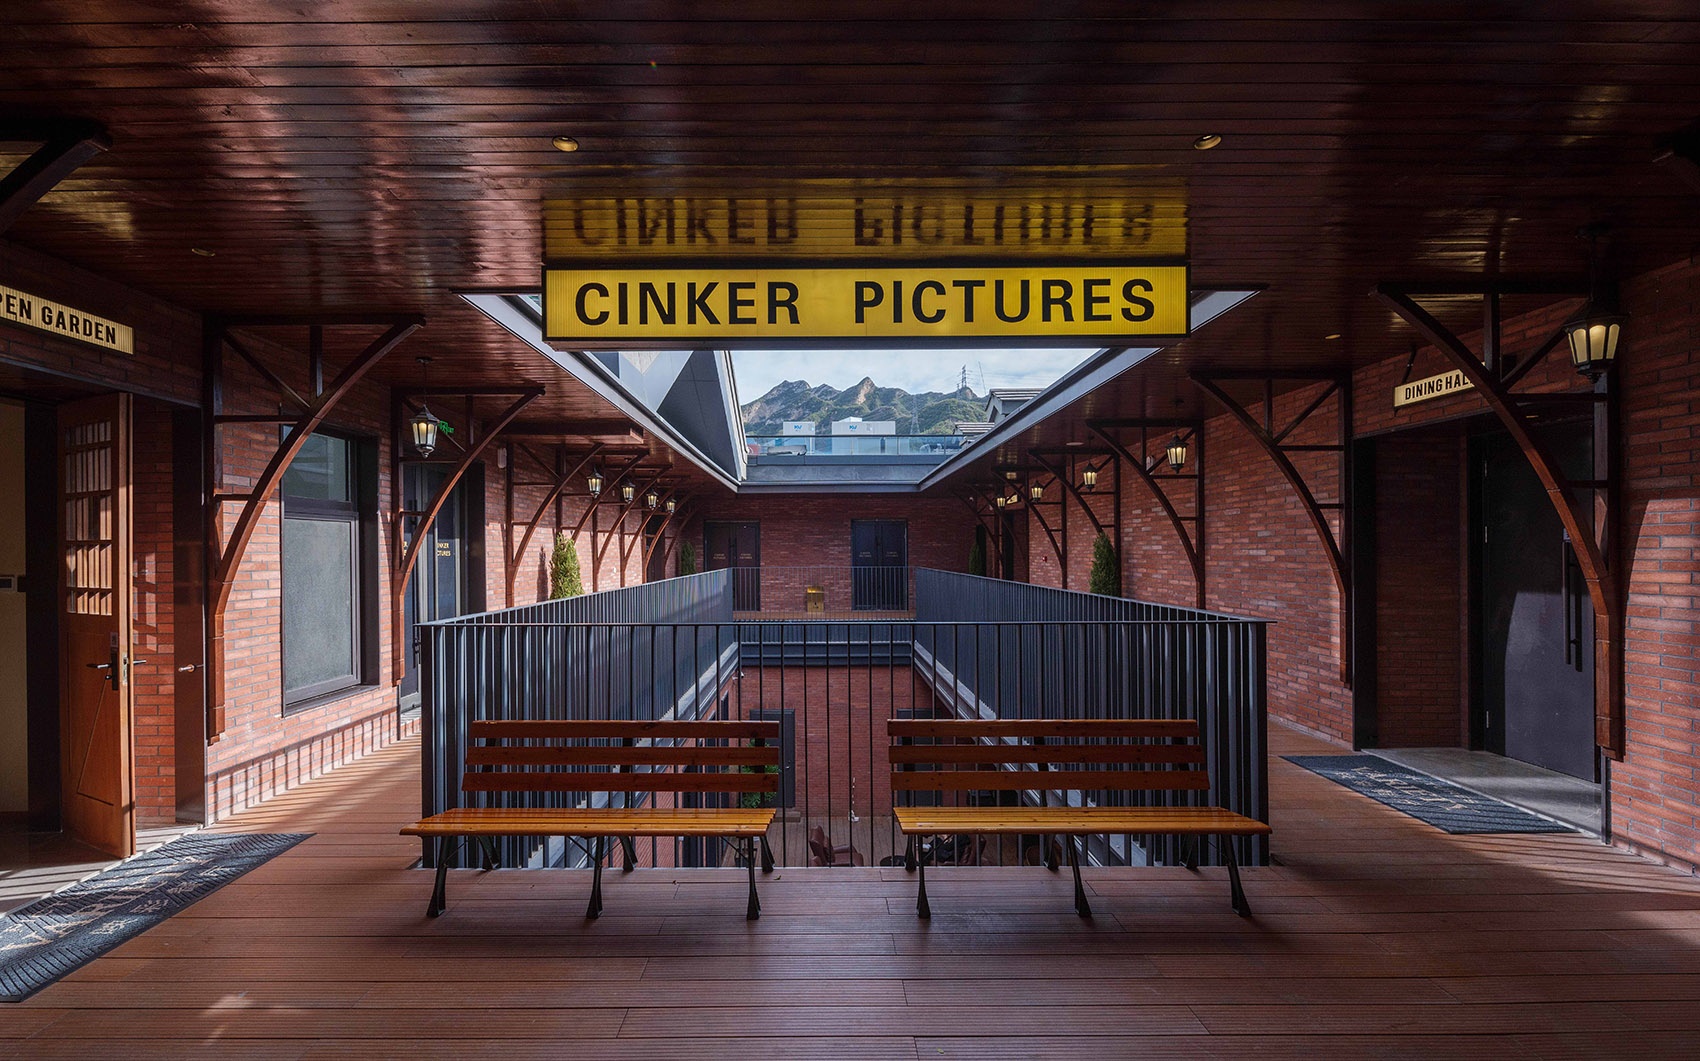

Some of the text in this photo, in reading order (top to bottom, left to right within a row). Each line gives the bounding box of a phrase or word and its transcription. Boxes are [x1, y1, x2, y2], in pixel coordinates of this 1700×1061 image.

[0, 293, 117, 345] EN GARDEN
[574, 278, 1155, 326] CINKER PICTURES
[1405, 373, 1472, 400] DINING HAL
